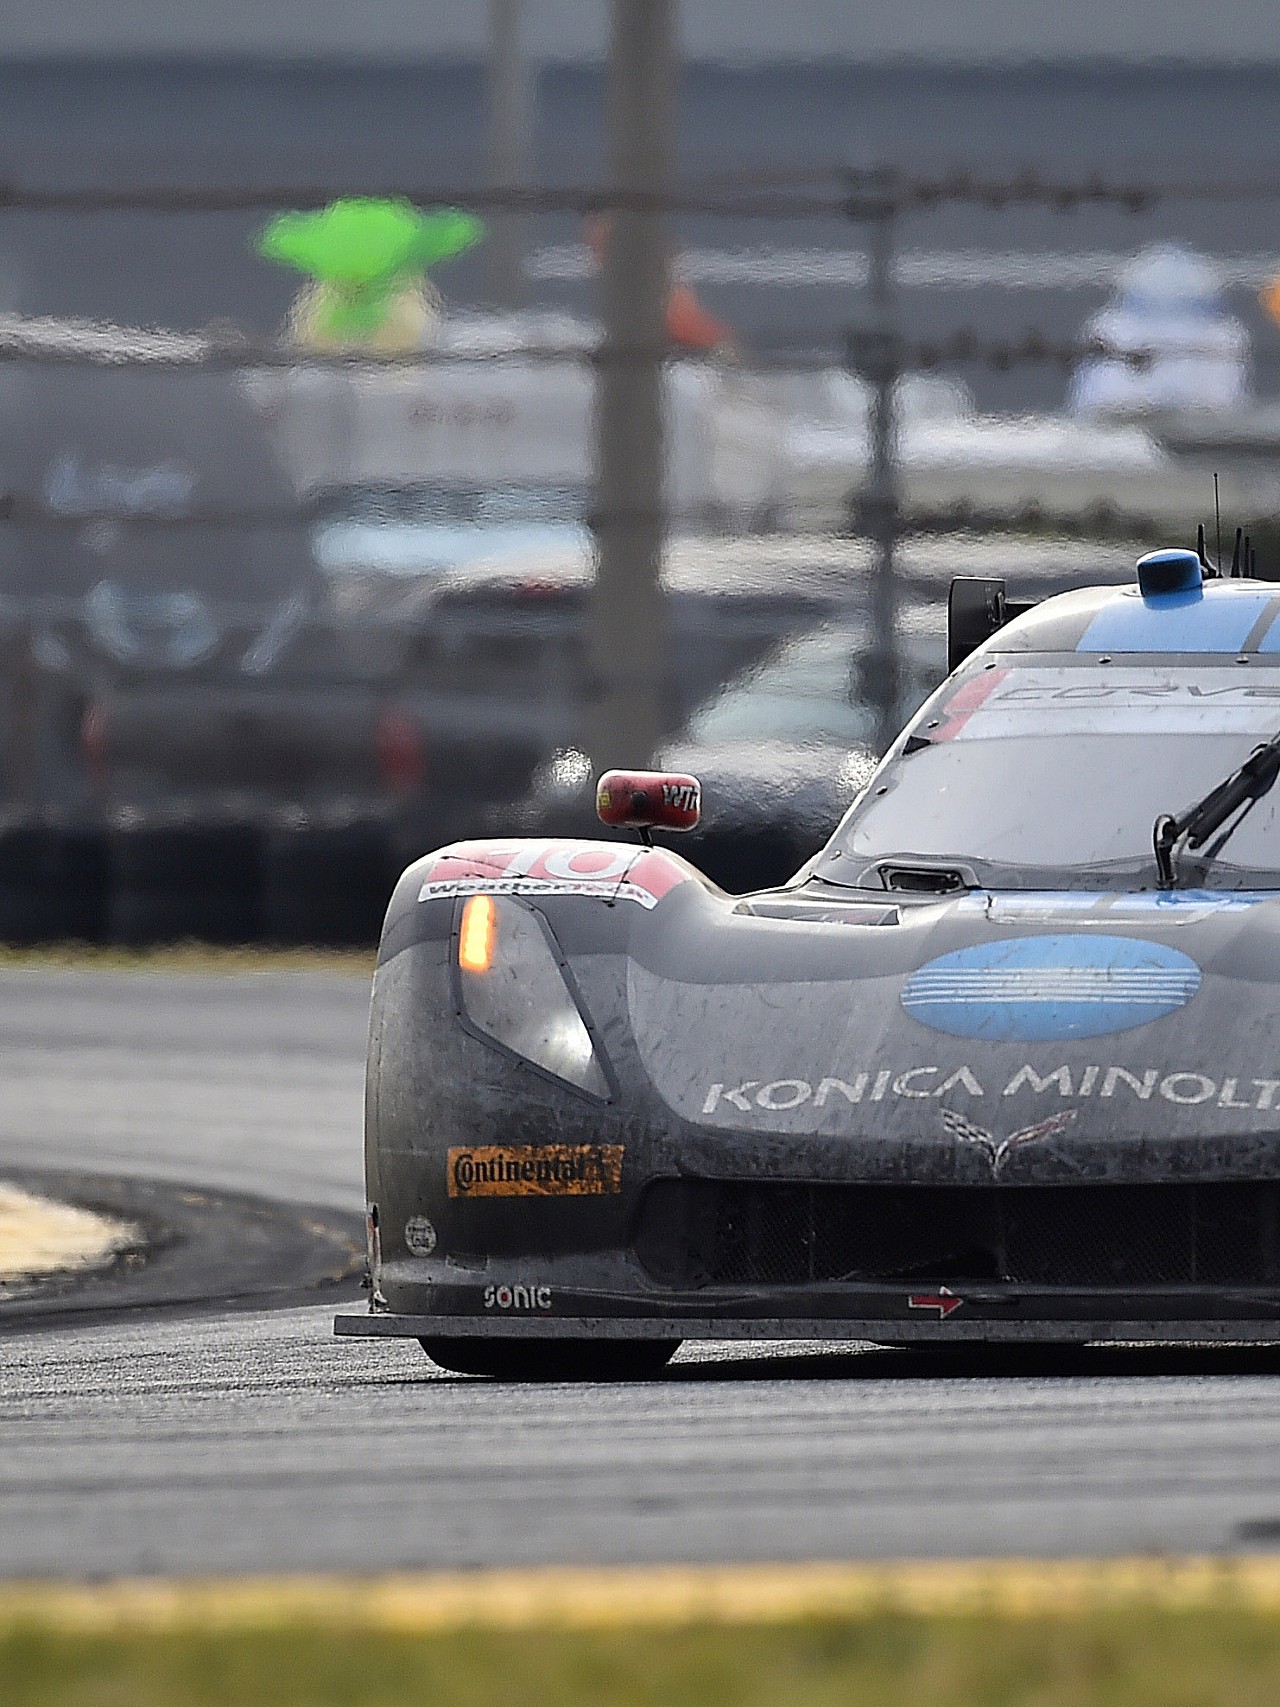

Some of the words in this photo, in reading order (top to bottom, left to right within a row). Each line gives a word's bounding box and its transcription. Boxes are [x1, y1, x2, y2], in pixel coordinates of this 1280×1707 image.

[488, 847, 642, 881] 10
[701, 1064, 985, 1114] KONICA
[454, 1154, 584, 1192] Continental
